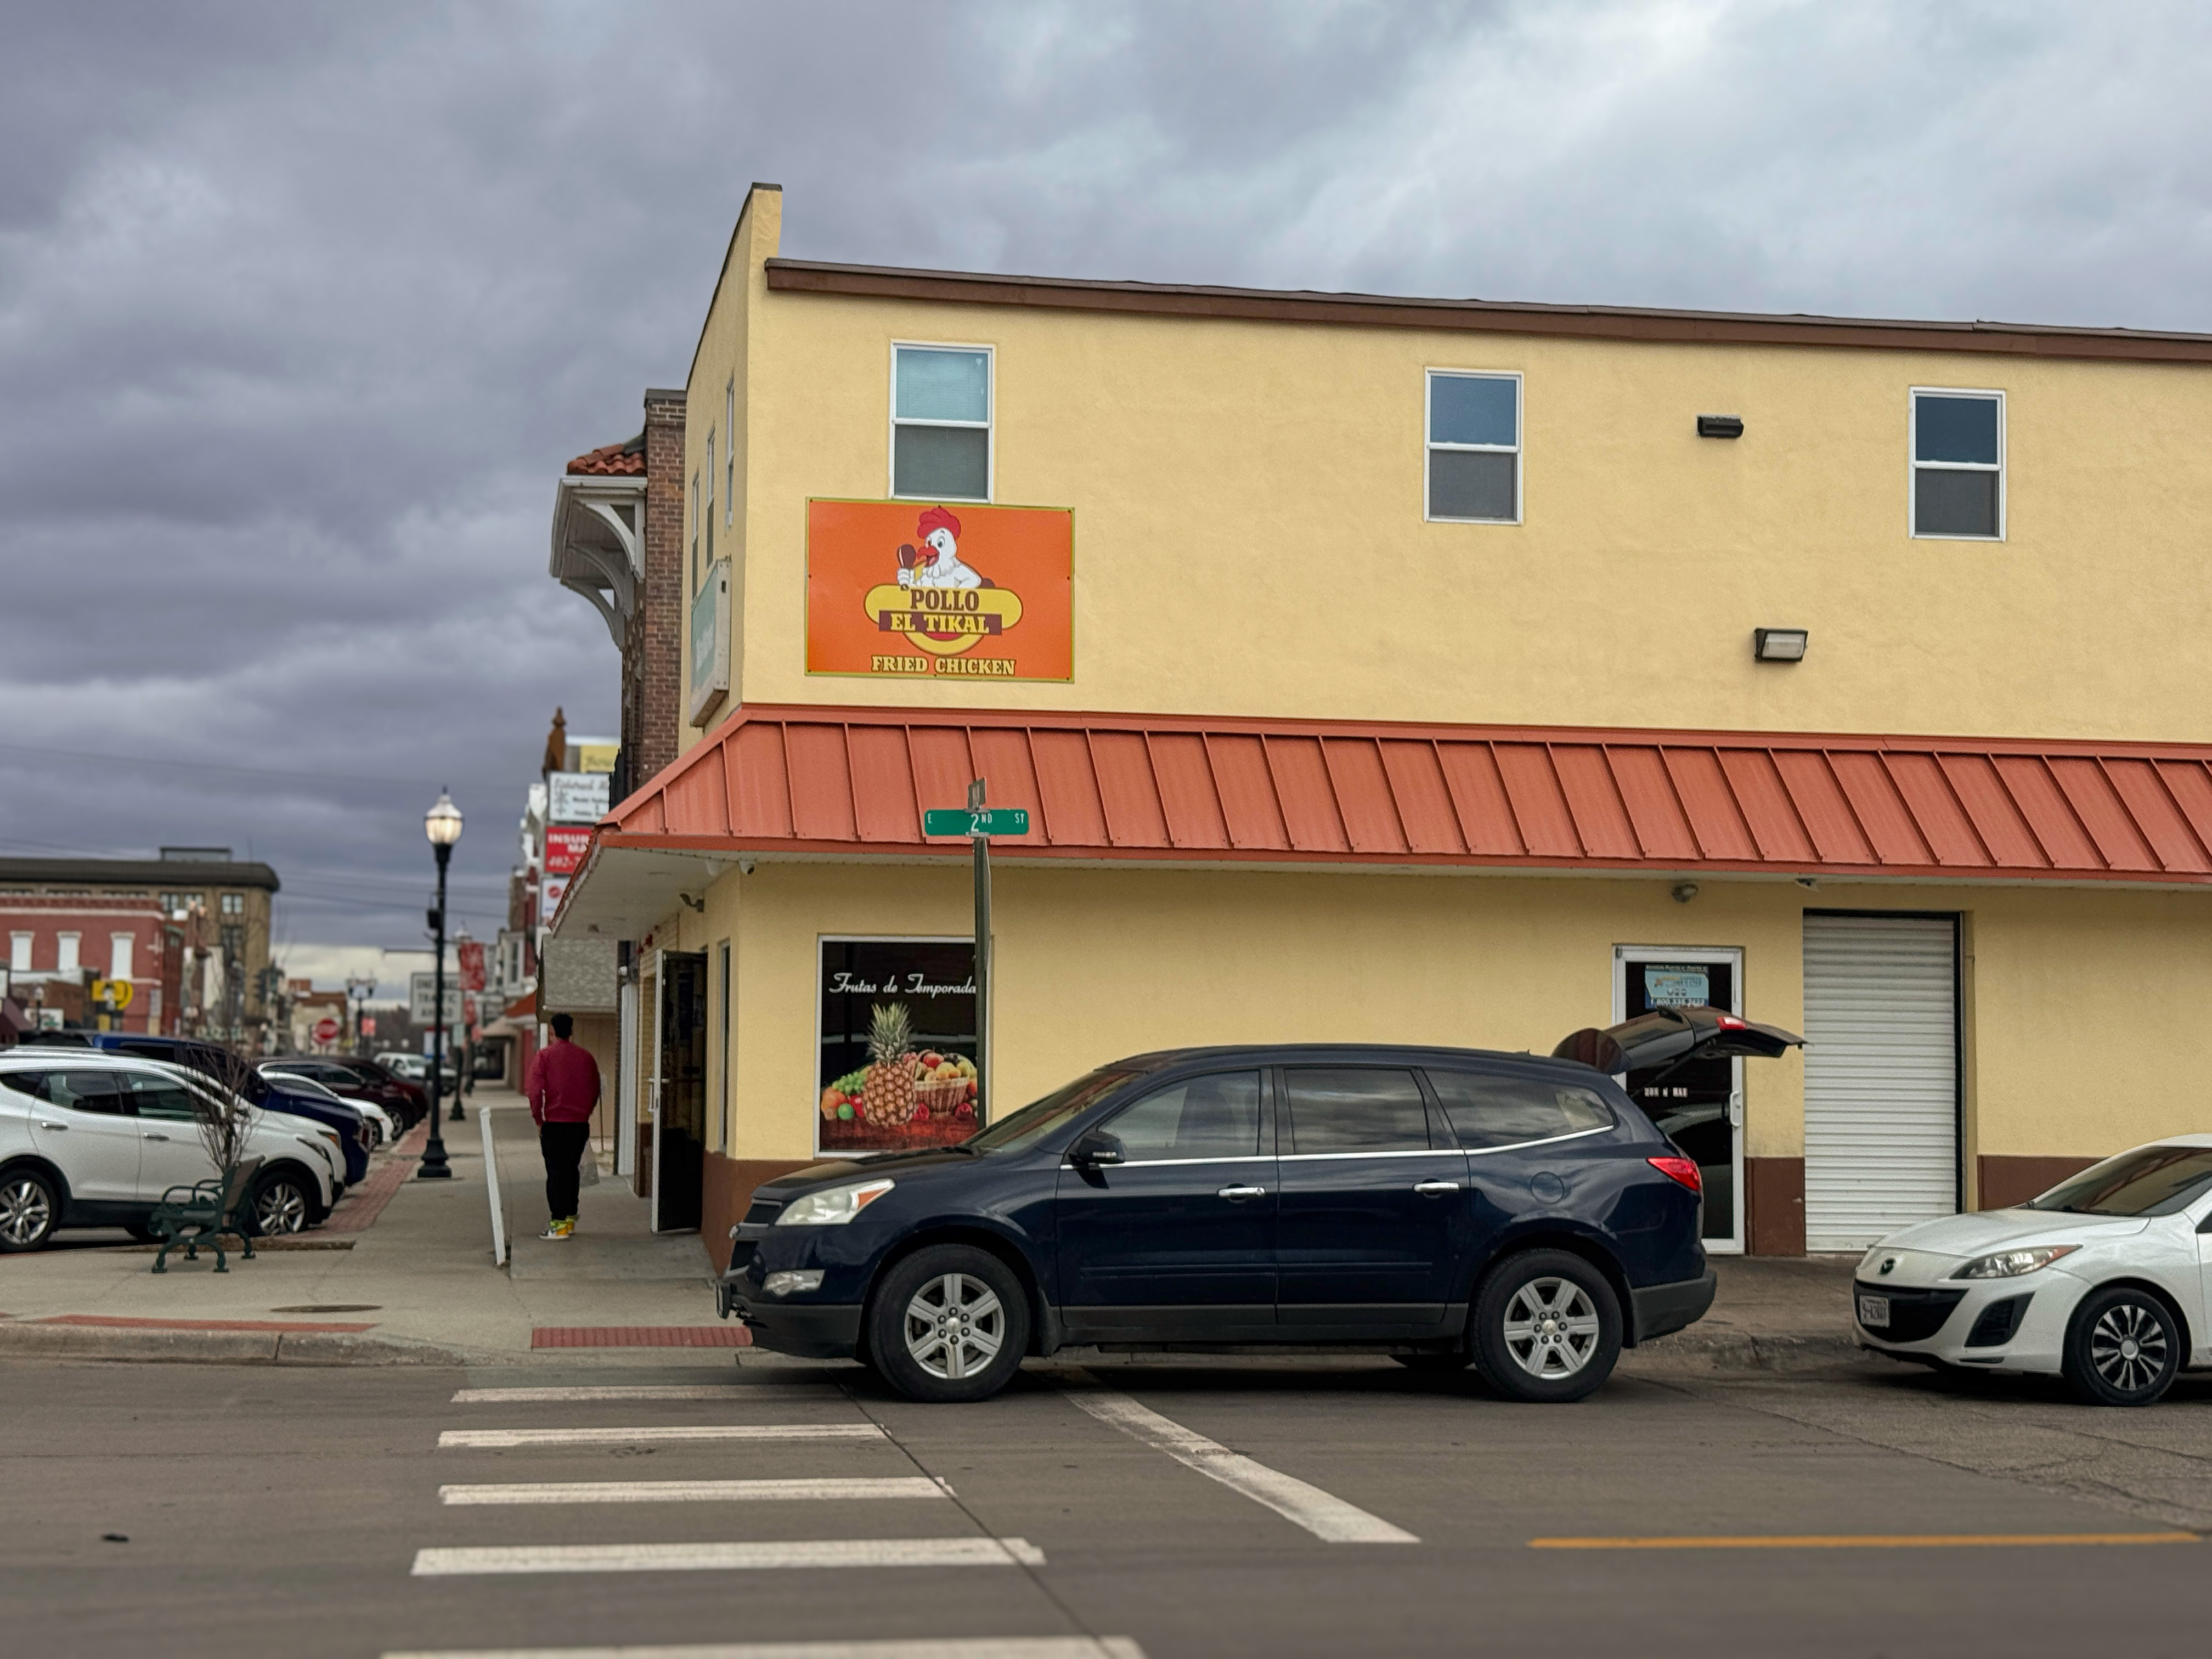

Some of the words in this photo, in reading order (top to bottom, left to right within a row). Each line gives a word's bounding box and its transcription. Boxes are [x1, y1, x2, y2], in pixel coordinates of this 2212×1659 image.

[910, 588, 980, 612] POLLO
[890, 613, 916, 631] EL
[923, 614, 990, 635] TIKAL
[871, 654, 928, 674] FRIED
[934, 657, 1017, 676] CHICKEN
[927, 813, 932, 824] E
[970, 814, 992, 832] 2ND
[1014, 813, 1024, 824] ST
[828, 972, 877, 994] Frutas
[883, 975, 898, 994] de
[904, 973, 977, 999] Temporada
